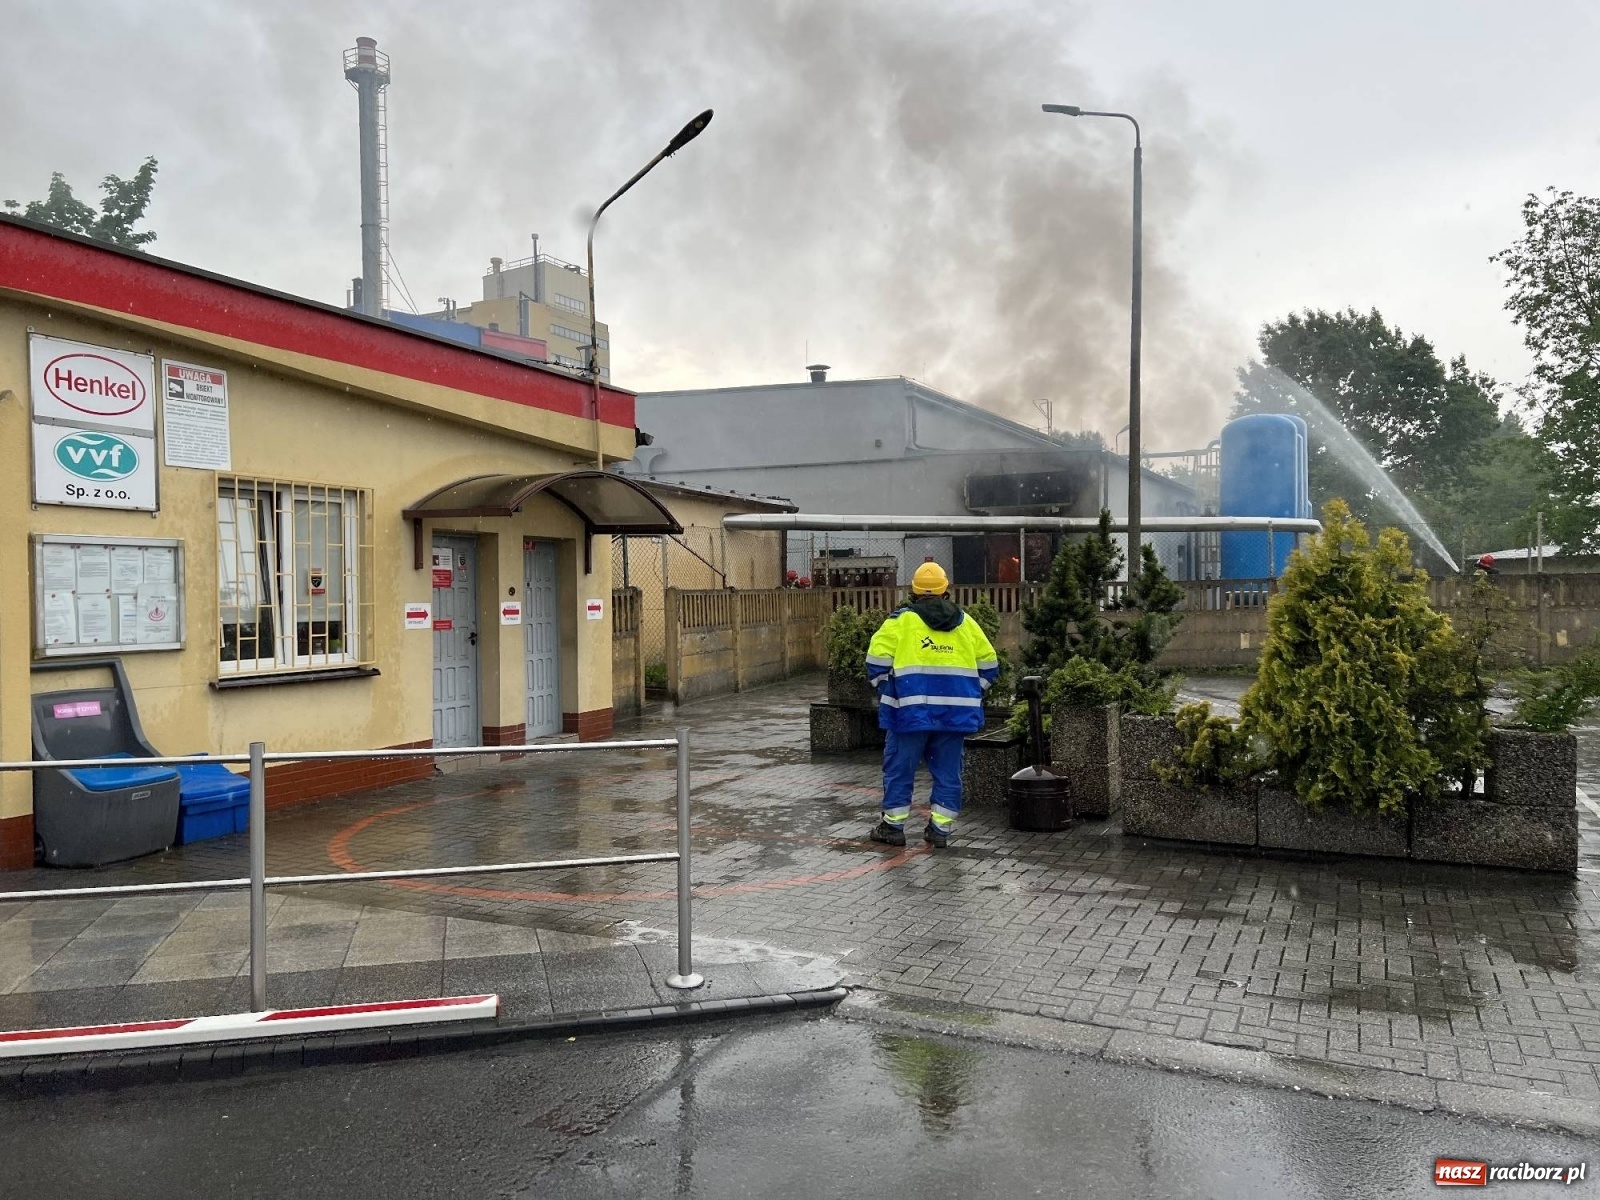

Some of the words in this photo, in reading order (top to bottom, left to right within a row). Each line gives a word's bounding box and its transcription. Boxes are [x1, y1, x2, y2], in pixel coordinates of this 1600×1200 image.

[54, 367, 136, 401] Henkel
[178, 368, 212, 384] UWAGA
[65, 444, 124, 468] vvf
[65, 483, 89, 499] Sp.
[93, 488, 101, 498] z
[105, 489, 131, 500] o.o.
